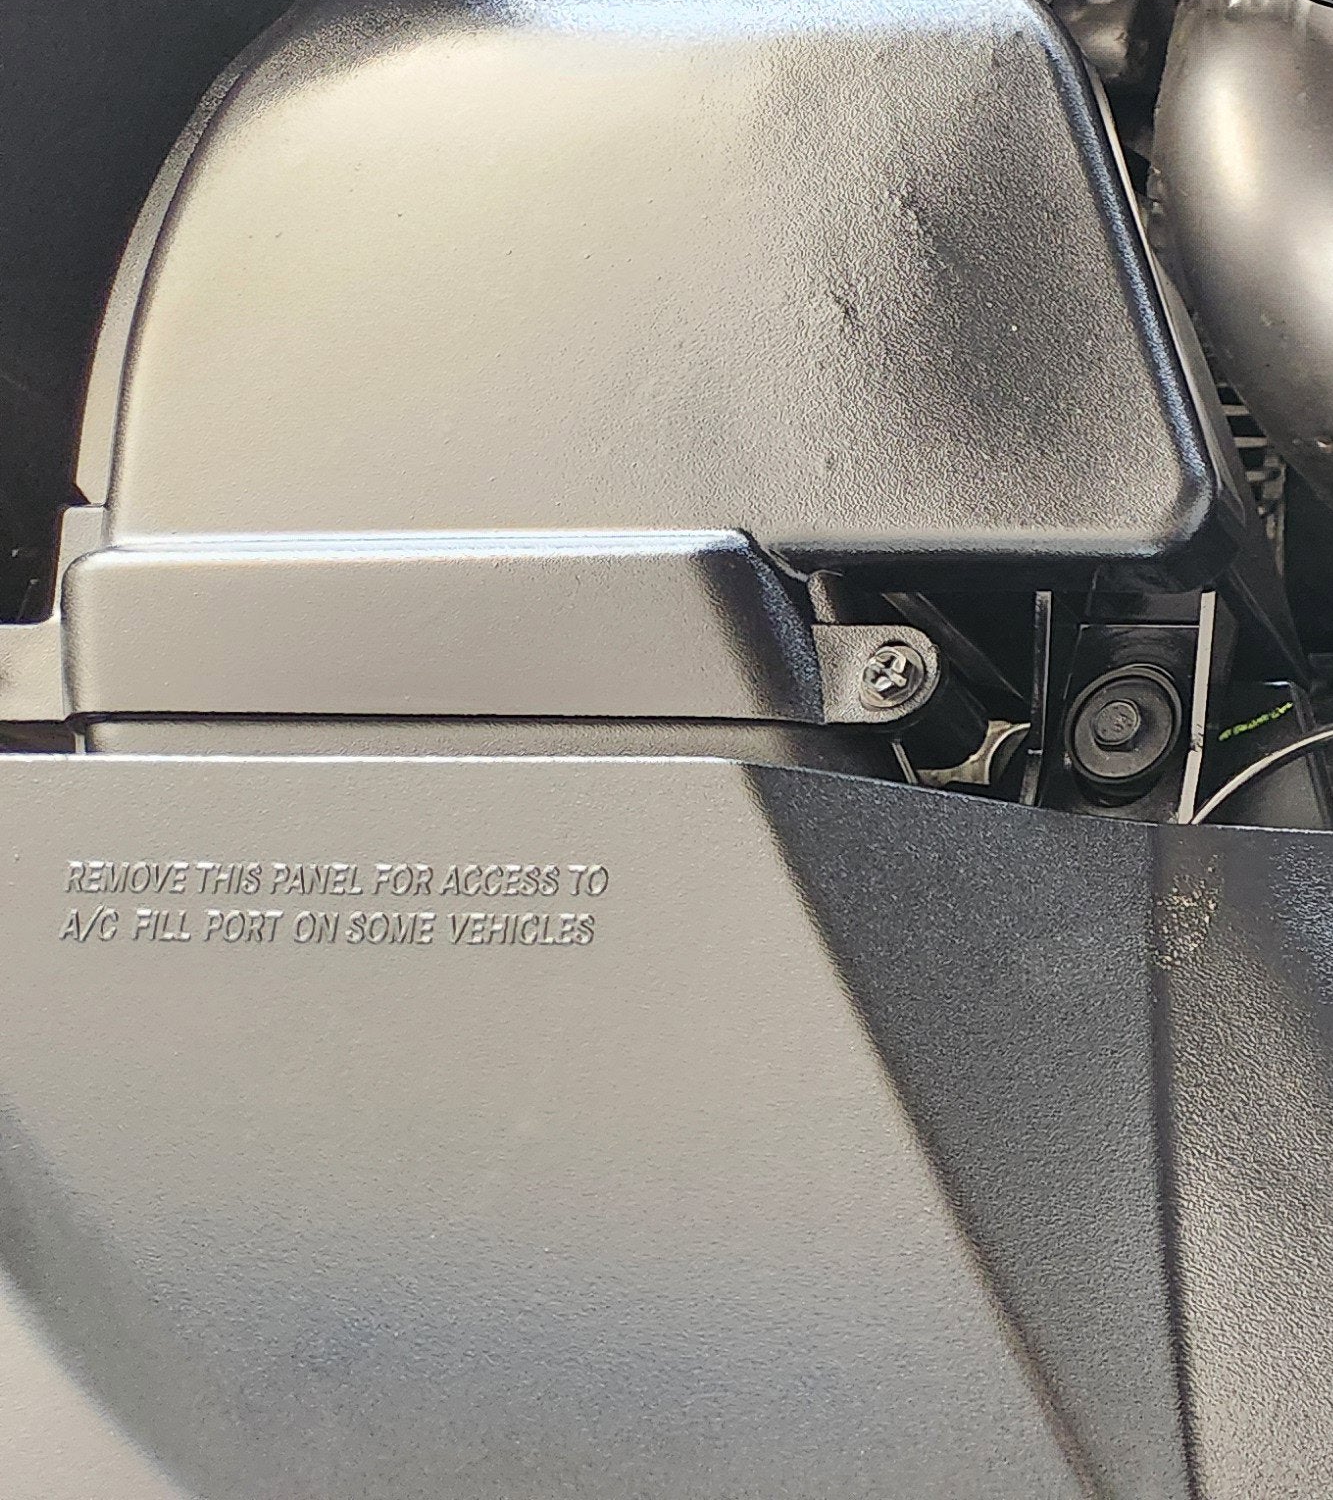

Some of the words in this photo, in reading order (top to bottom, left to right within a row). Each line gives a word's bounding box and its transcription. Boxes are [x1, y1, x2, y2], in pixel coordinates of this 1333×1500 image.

[64, 860, 191, 894] REMOVE
[194, 861, 263, 894] THIS
[270, 861, 363, 895] PANEL
[373, 862, 434, 896] FOR
[439, 863, 561, 897] ACCESS
[567, 863, 609, 897] TO
[58, 903, 120, 944] A/C
[132, 907, 192, 942] FILL
[203, 908, 285, 943] PORT
[293, 910, 340, 944] ON
[345, 910, 437, 946] SOME
[447, 912, 596, 947] VEHICLES
